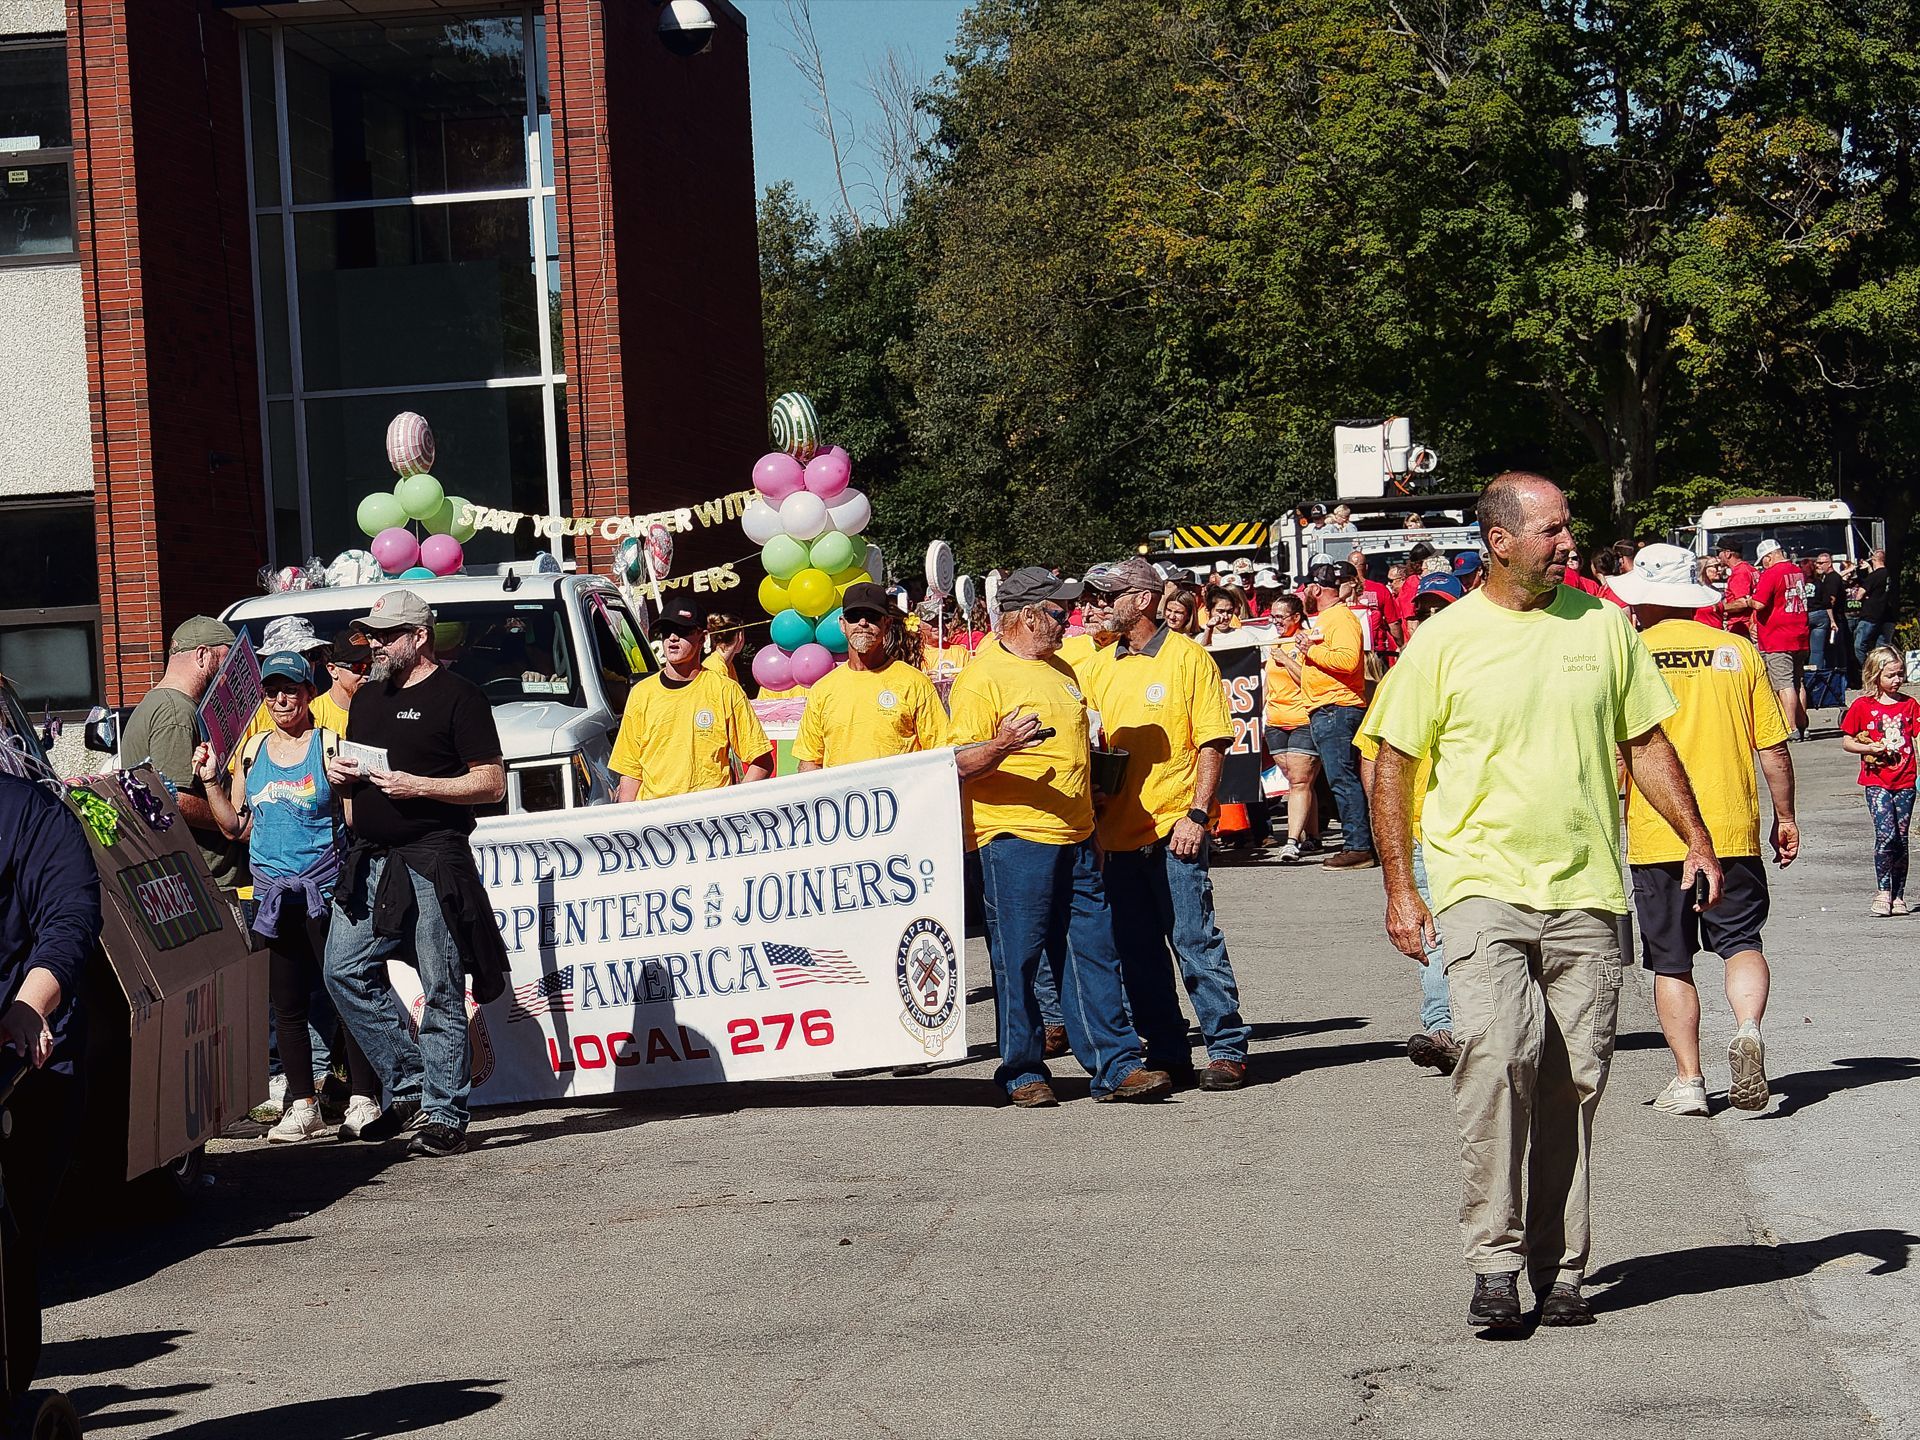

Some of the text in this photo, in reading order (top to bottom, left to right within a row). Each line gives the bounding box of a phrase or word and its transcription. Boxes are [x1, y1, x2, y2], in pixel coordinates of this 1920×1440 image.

[1353, 443, 1377, 453] Altec
[458, 489, 763, 541] START YOUR CAREER WITH
[631, 563, 741, 602] PENTERS
[1562, 653, 1597, 663] Rushford
[1562, 663, 1600, 674] Labor Day
[1652, 650, 1714, 668] REW
[227, 668, 248, 720] MEANS
[234, 648, 258, 710] SEIZE THE
[1220, 675, 1259, 714] RS'
[396, 708, 421, 720] cake
[1230, 716, 1260, 755] 21
[270, 790, 313, 810] Revolution
[271, 781, 305, 792] Rainbow
[473, 787, 900, 888] NITED BROTHERHOOD
[493, 885, 694, 953] RPENTERS
[732, 854, 919, 926] JOINERS
[898, 920, 955, 966] CARPENTERS
[580, 943, 770, 1011] AMERICA
[898, 968, 957, 1027] WESTERN NEW YORK
[548, 1009, 835, 1073] LOCAL 276
[902, 1010, 959, 1038] LOCAL UNION
[925, 1034, 941, 1049] 276
